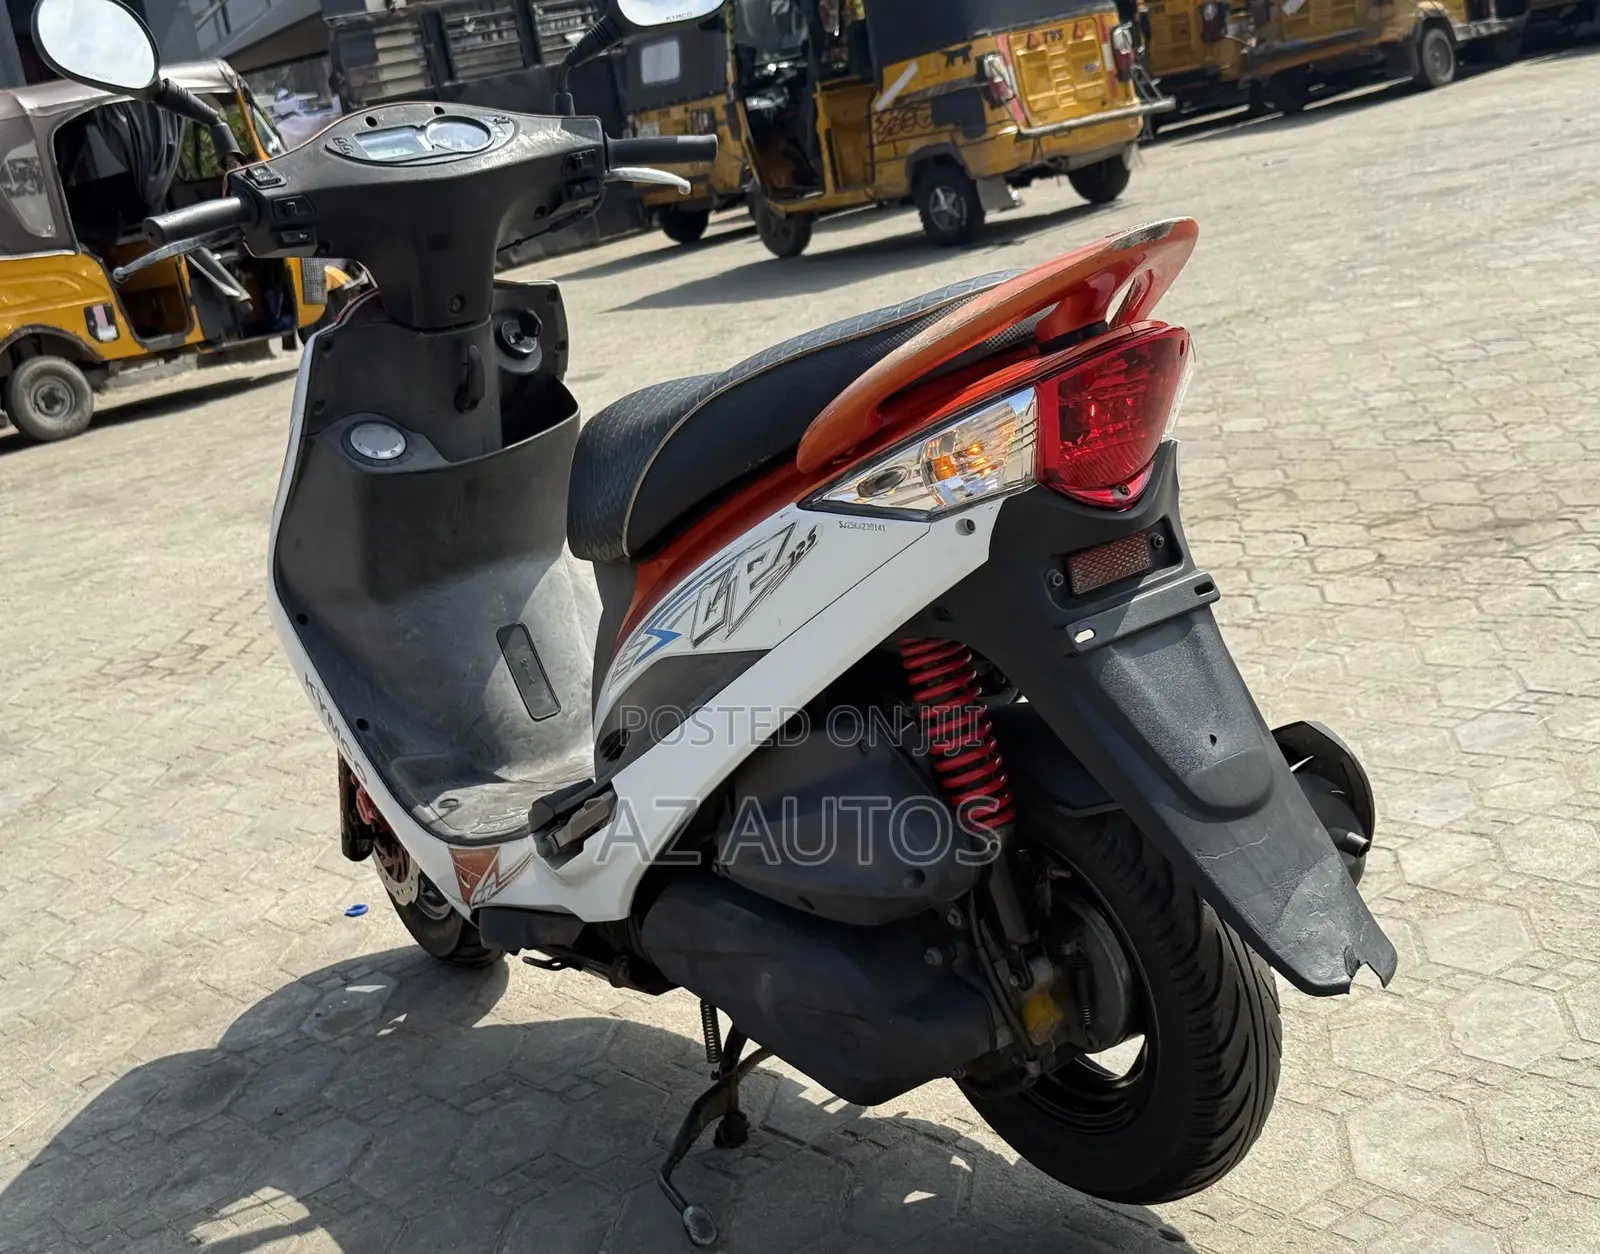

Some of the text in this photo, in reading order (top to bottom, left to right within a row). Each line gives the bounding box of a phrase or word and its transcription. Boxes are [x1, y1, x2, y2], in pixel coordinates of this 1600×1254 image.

[1042, 28, 1065, 44] TVS
[787, 524, 818, 569] 125
[304, 671, 368, 786] KYMCO
